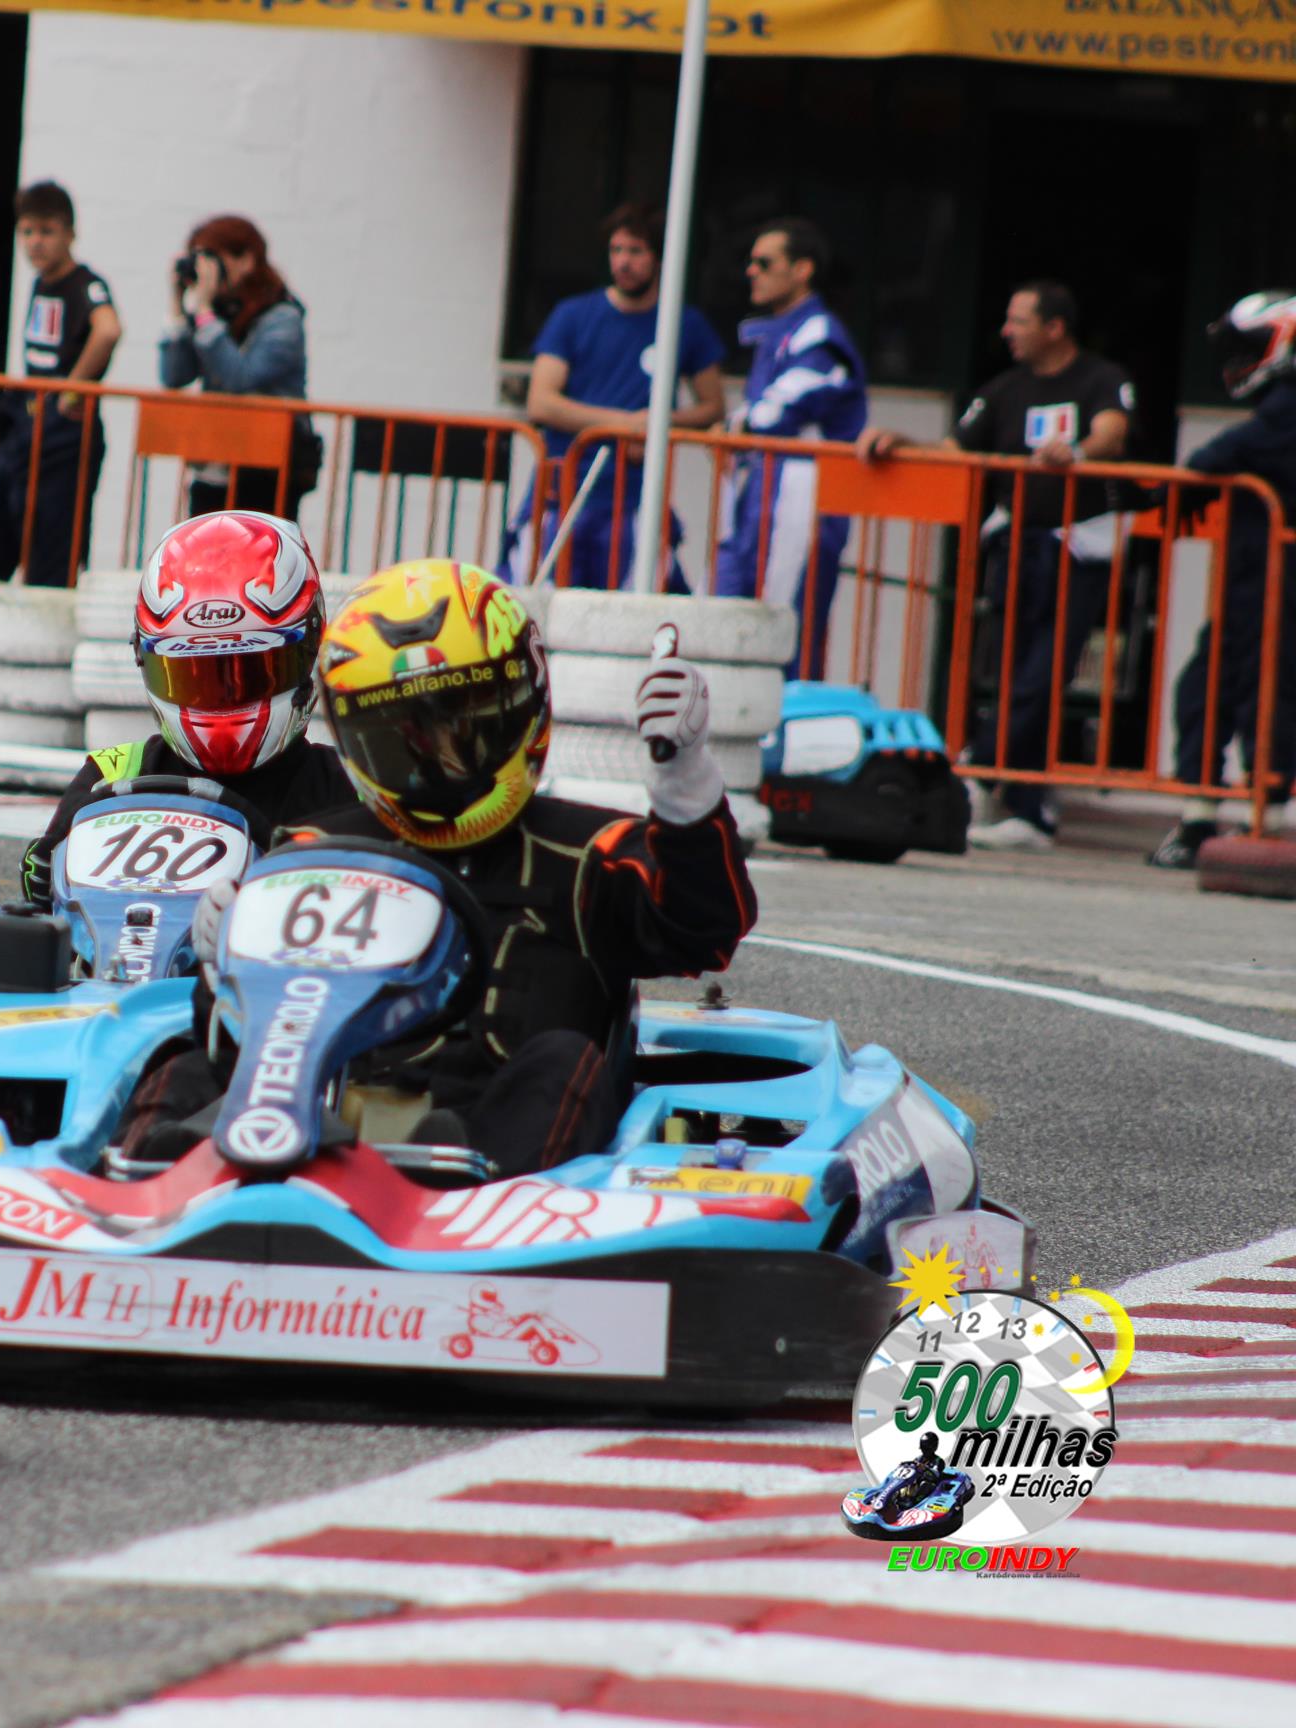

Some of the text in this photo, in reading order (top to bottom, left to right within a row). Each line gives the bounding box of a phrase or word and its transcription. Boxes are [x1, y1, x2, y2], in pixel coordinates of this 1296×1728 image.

[188, 603, 238, 622] Arai
[167, 637, 269, 652] DESIGN
[355, 665, 494, 708] www.alfano.be
[92, 813, 225, 832] EUROINDY
[88, 824, 227, 881] 160
[281, 882, 380, 951] 64
[698, 1176, 795, 1197] eni
[165, 1277, 428, 1345] Informática
